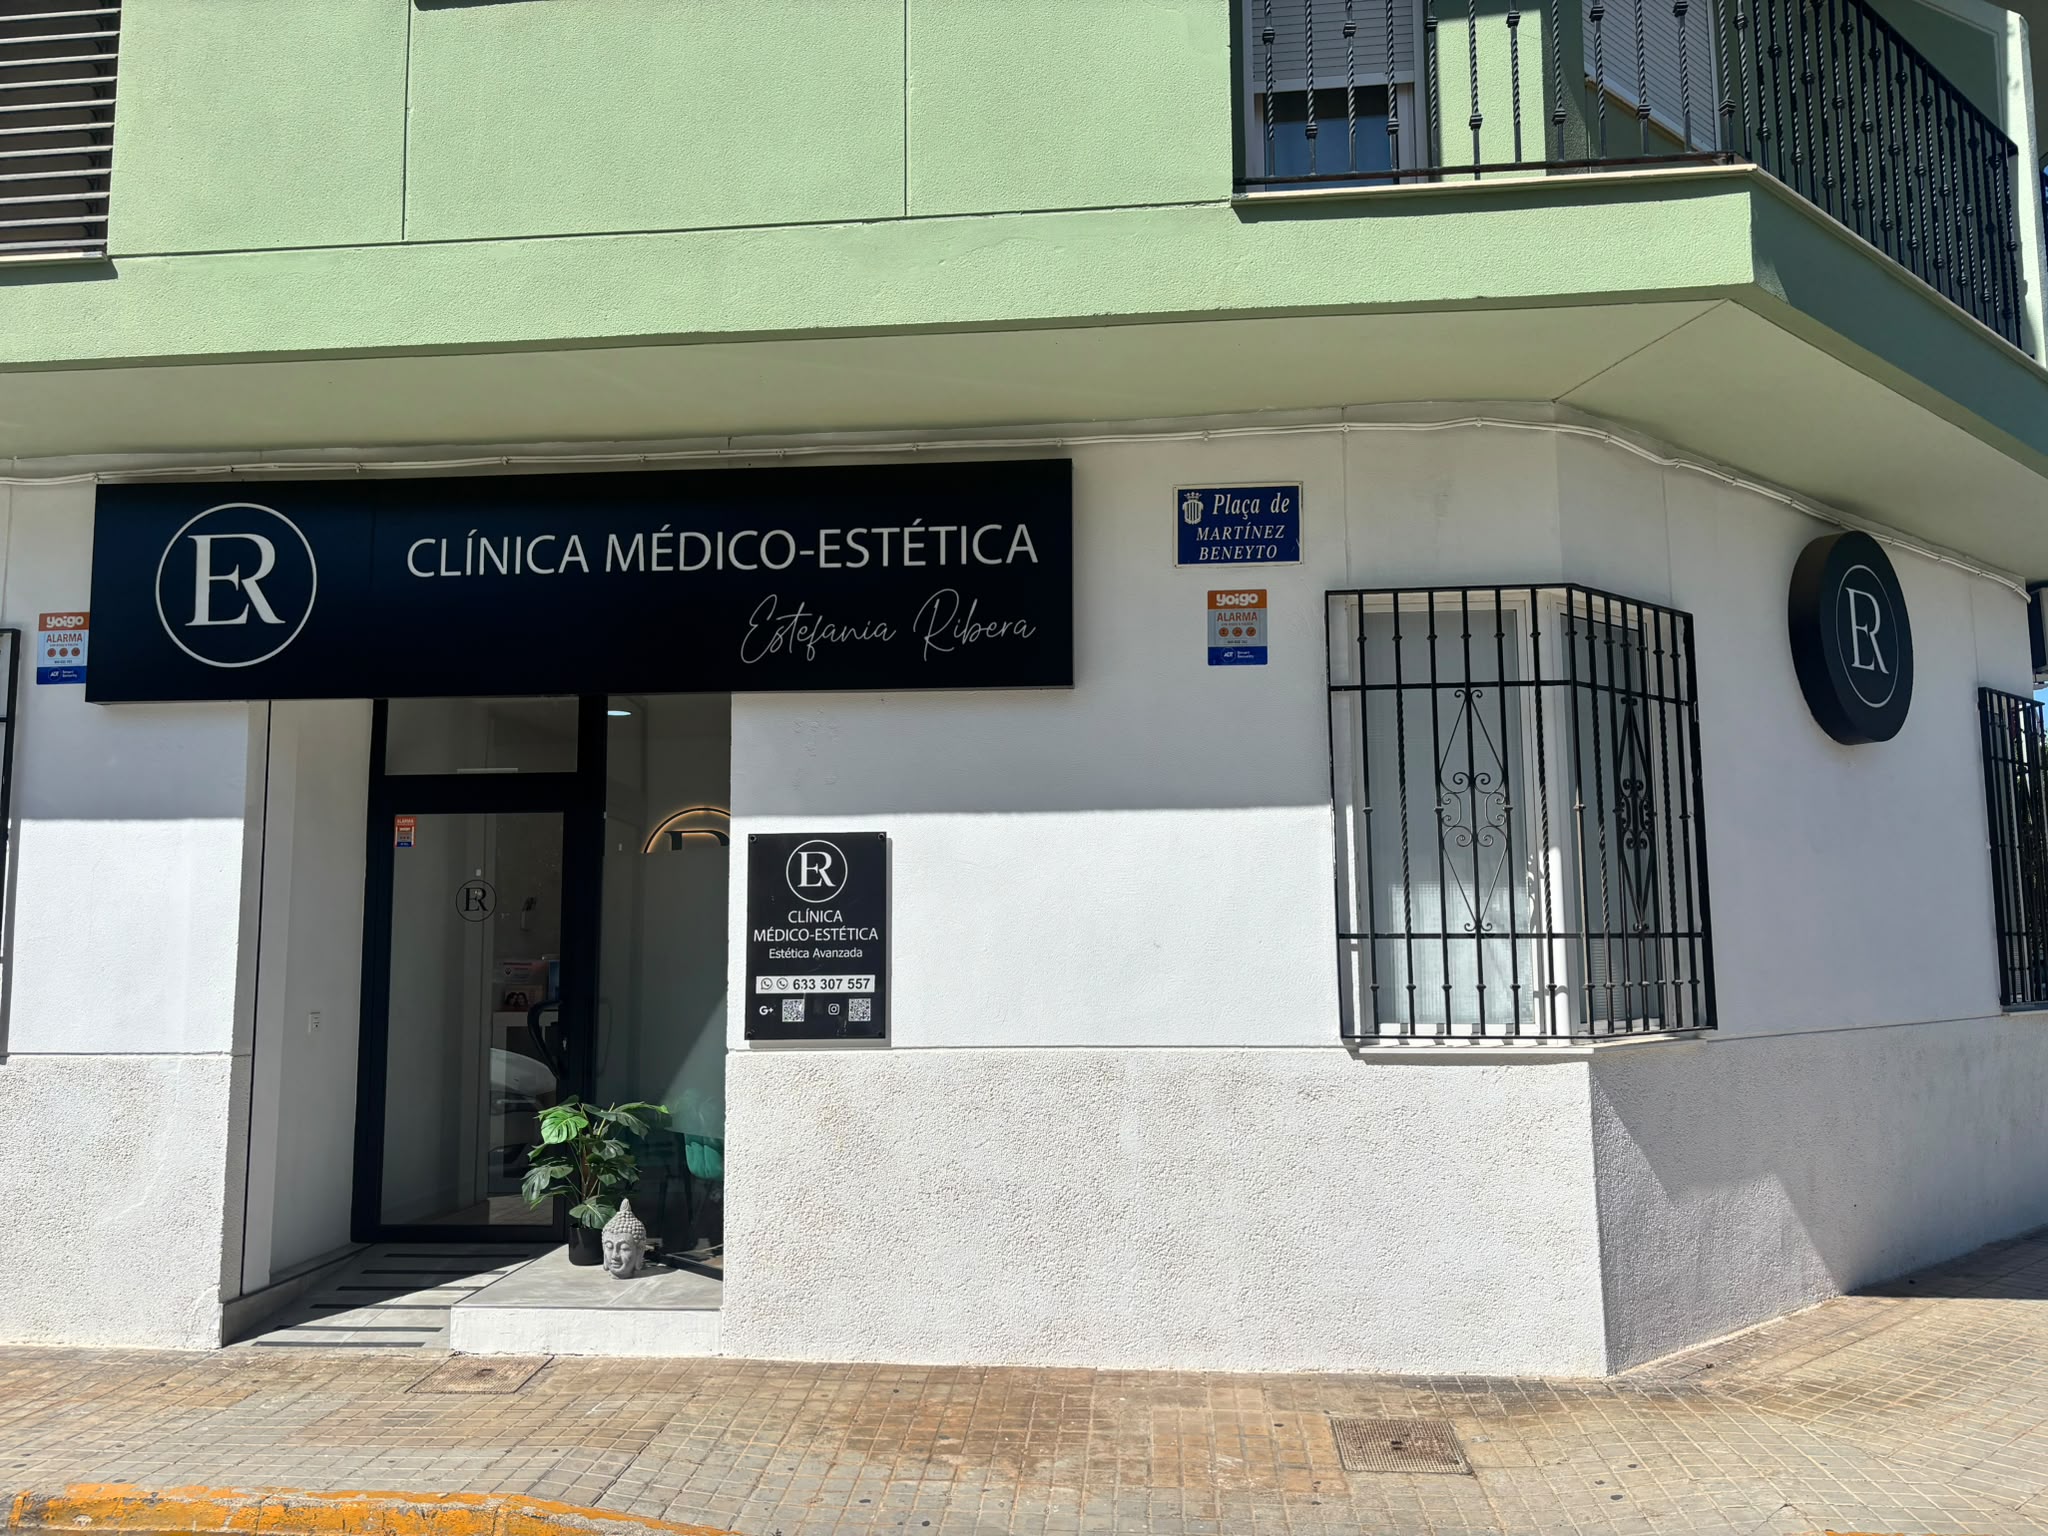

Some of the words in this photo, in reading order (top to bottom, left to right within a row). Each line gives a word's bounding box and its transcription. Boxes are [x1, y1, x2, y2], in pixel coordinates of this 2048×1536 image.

[1212, 494, 1260, 520] Plaça
[1270, 492, 1290, 514] de
[1196, 522, 1286, 541] MARTÍNEZ
[406, 529, 590, 577] CLÍNICA
[605, 519, 1038, 573] MÉDICO-ESTÉTICA
[1199, 545, 1278, 561] BENEYTO
[1216, 593, 1258, 606] yoigo
[46, 616, 84, 628] yoigo
[1217, 612, 1258, 622] ALARMA
[740, 594, 897, 664] Estefania
[913, 588, 1036, 661] Ribera
[46, 633, 83, 643] ALARMA
[788, 908, 843, 924] CLÍNICA
[753, 926, 879, 942] MÉDICO-ESTÉTICA
[769, 948, 809, 959] Estética
[812, 947, 863, 959] Avanzada
[793, 979, 816, 990] 633
[820, 978, 843, 989] 307
[847, 978, 870, 989] 557
